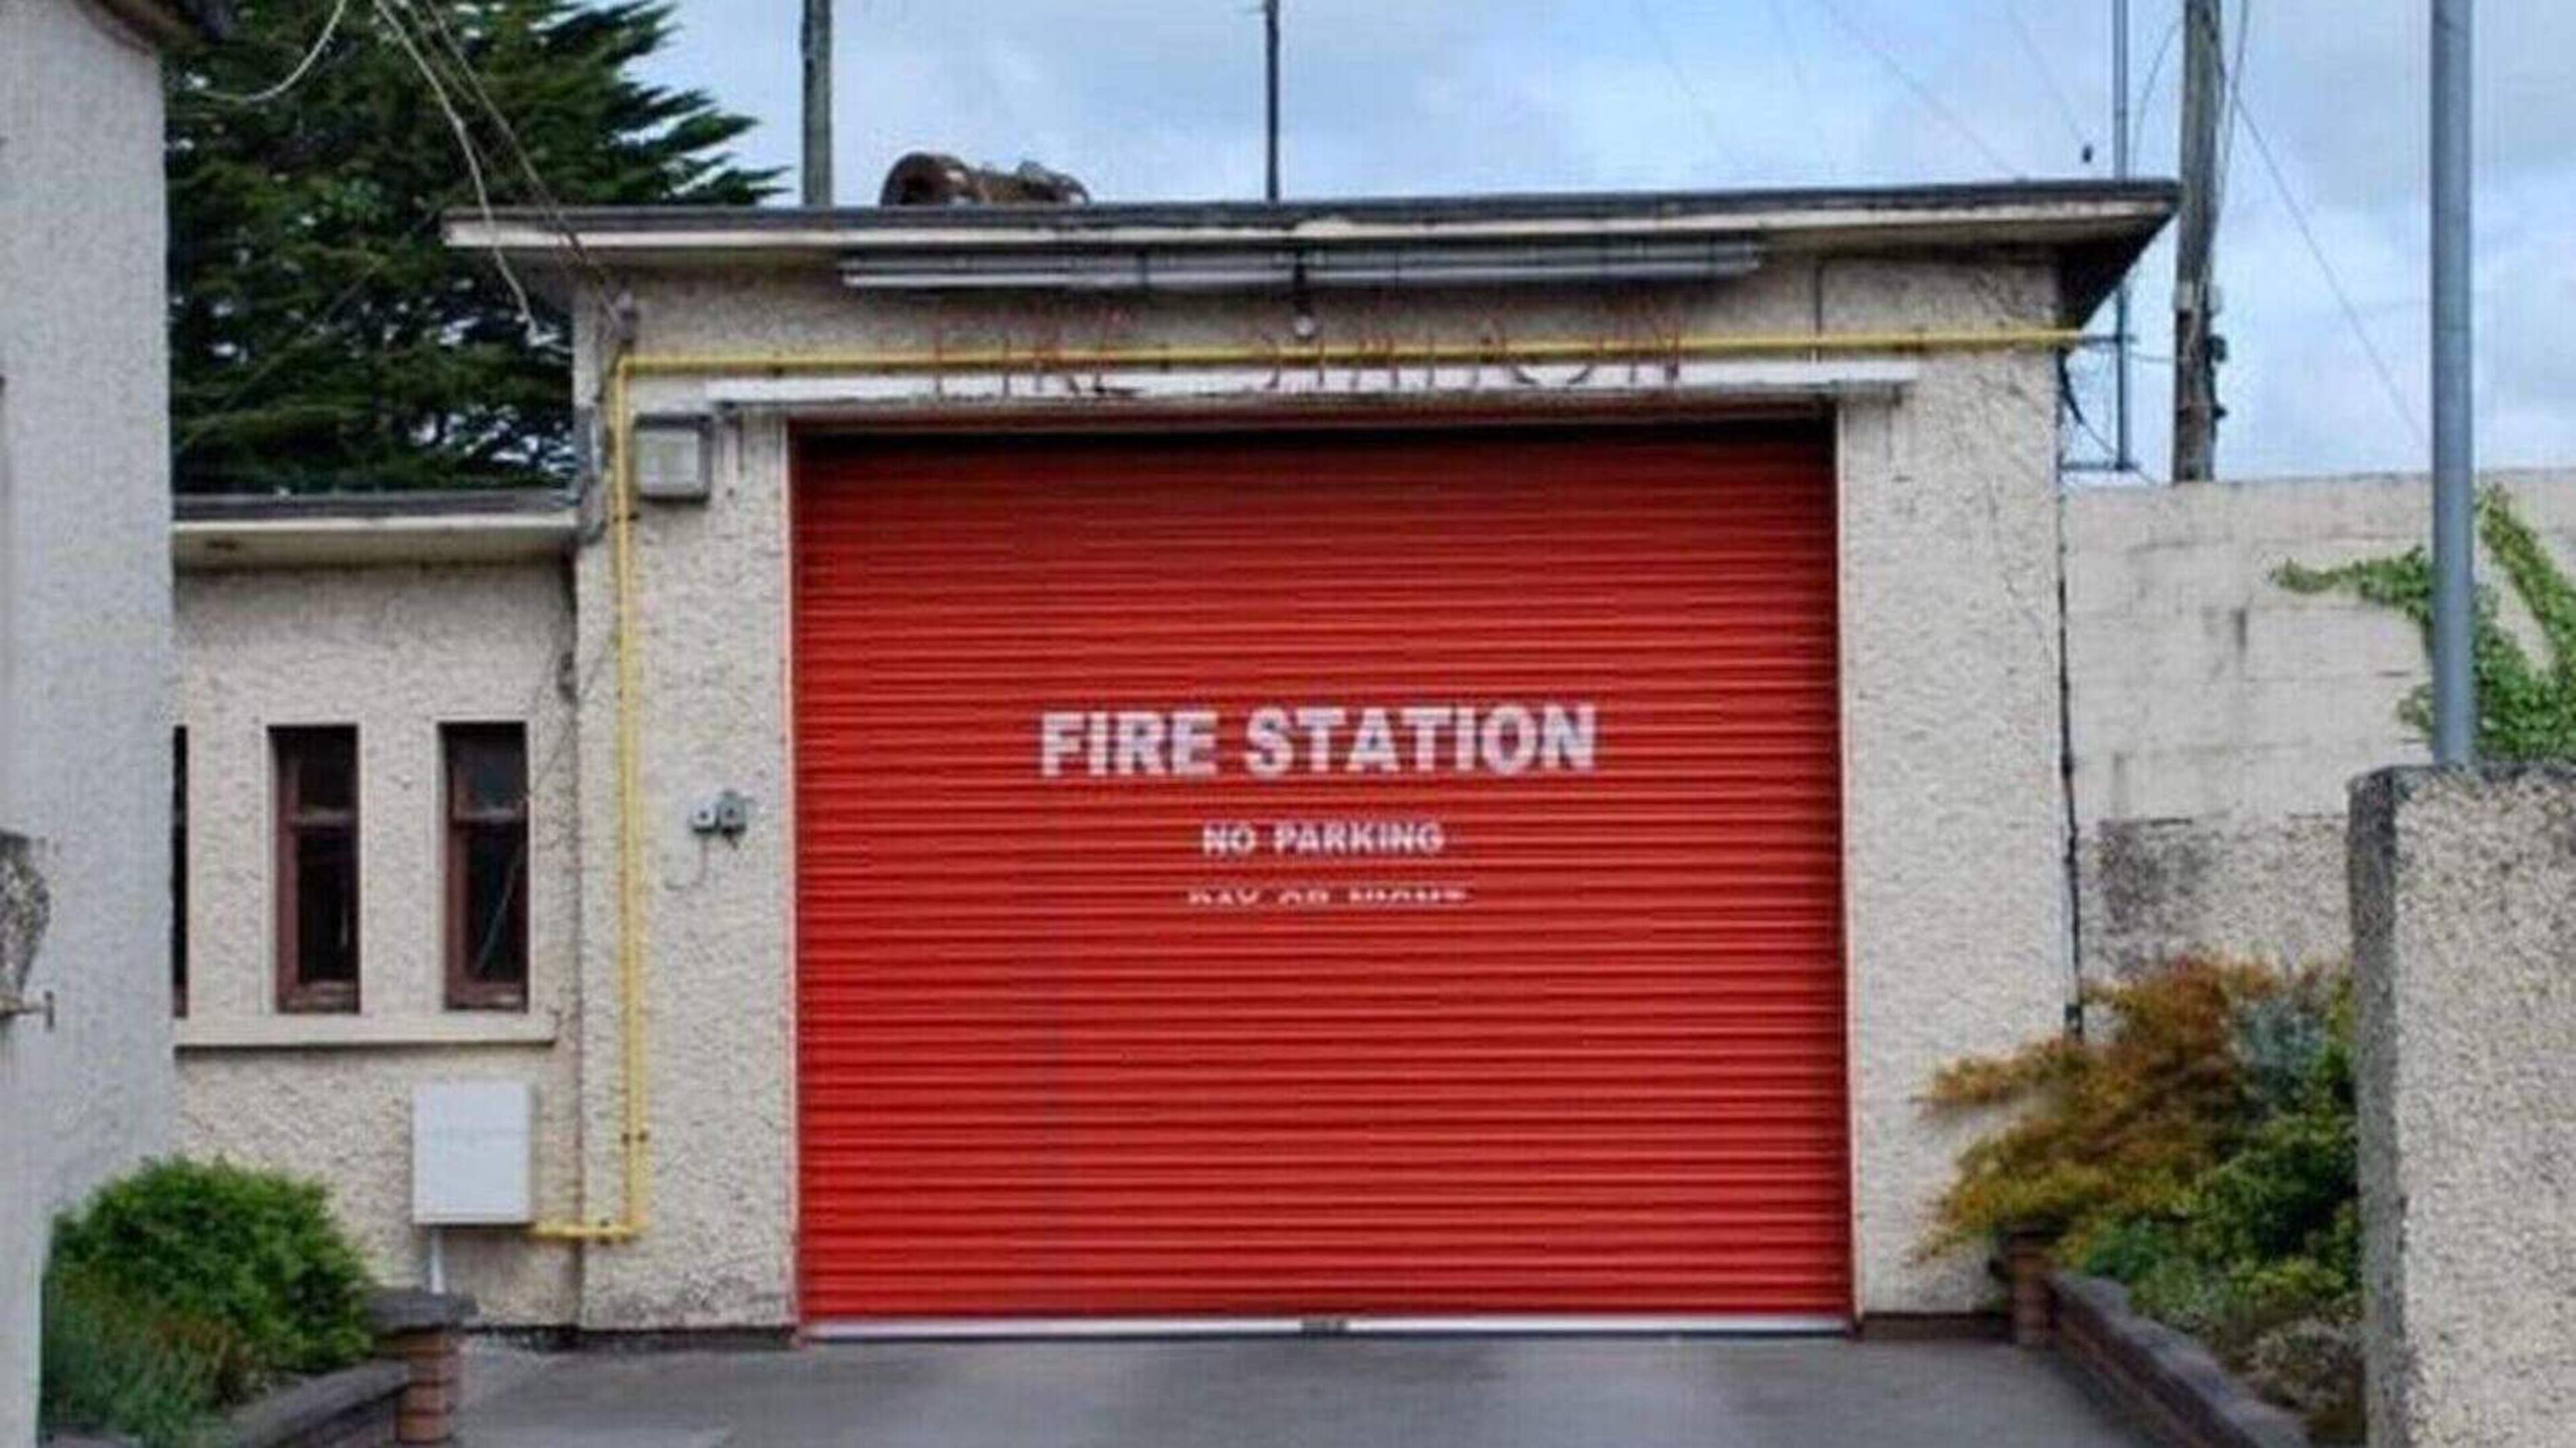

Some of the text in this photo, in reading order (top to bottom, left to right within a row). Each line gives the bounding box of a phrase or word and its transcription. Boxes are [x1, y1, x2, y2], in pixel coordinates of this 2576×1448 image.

[1040, 705, 1597, 778] FIRE STATION
[1202, 819, 1446, 855] NO PARKING
